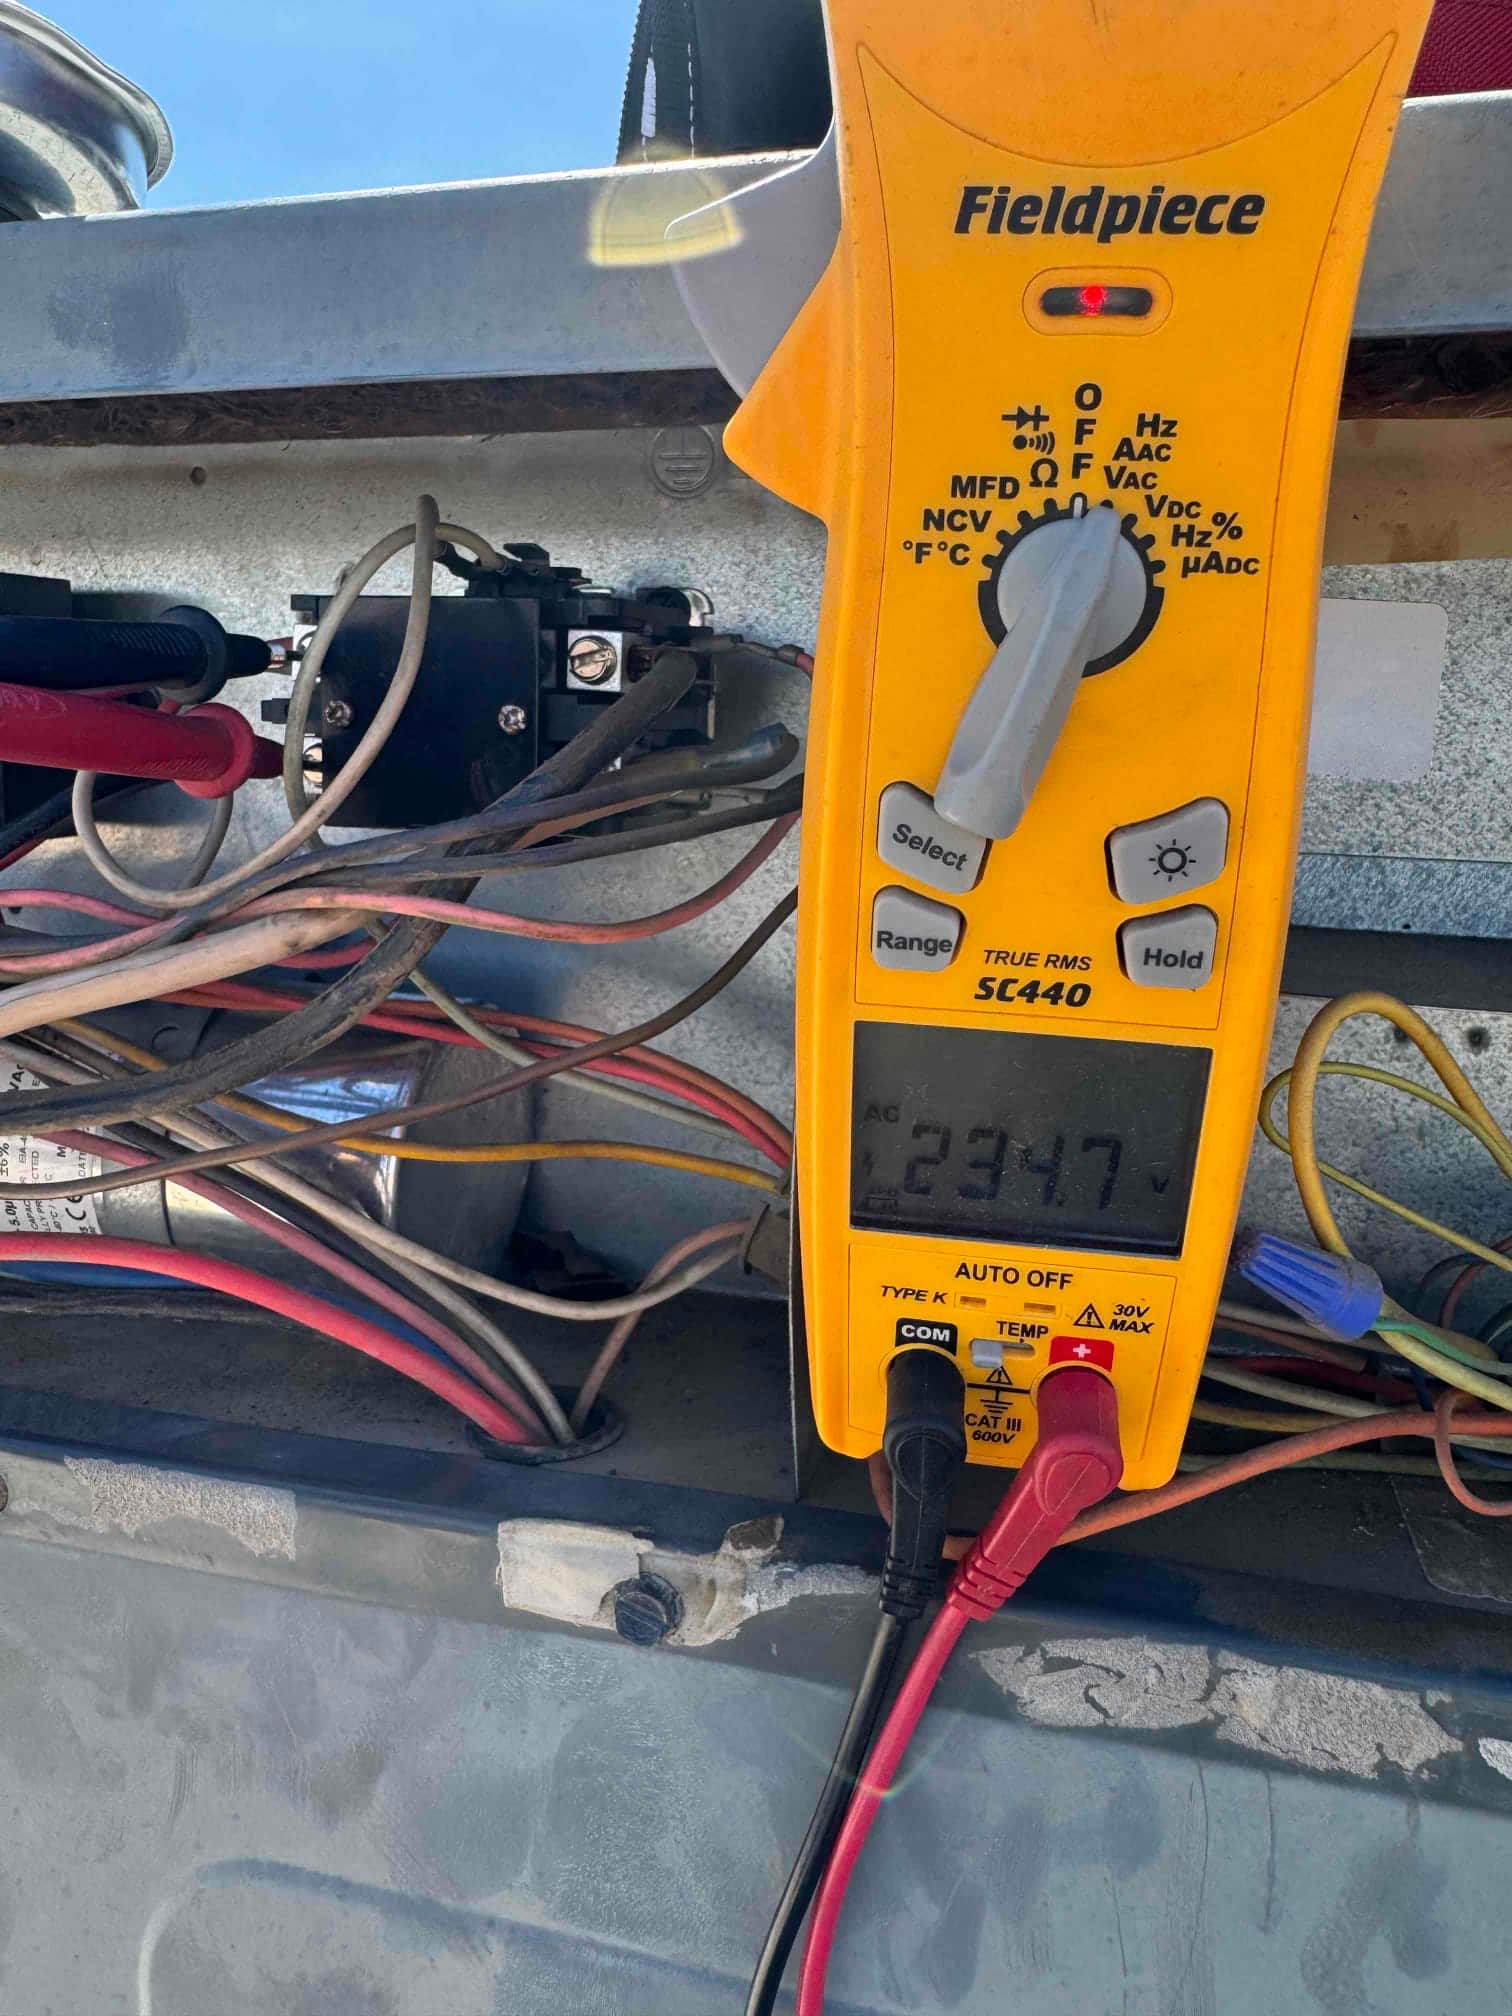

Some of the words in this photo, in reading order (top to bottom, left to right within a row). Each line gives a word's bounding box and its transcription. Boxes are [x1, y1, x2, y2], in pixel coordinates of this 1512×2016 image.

[954, 185, 1265, 244] Fieldpiece
[1136, 413, 1178, 438] Hz
[1112, 438, 1172, 462] AAC
[951, 475, 1020, 500] MFD
[1103, 465, 1158, 490] VAC
[1145, 495, 1201, 519] VDC
[923, 509, 992, 532] NCV
[892, 824, 968, 872] Select
[876, 931, 953, 957] Range
[983, 949, 1039, 967] TRUE
[1044, 954, 1092, 971] RMS
[1143, 948, 1204, 969] Hold
[974, 977, 1092, 1008] SC440
[864, 1105, 899, 1123] AC
[955, 1263, 1020, 1284] AUTO
[1027, 1271, 1073, 1290] OFF
[880, 1285, 928, 1302] TYPE
[933, 1291, 949, 1305] K
[1113, 1304, 1150, 1318] 30V
[901, 1325, 950, 1342] COM
[996, 1320, 1049, 1340] TEMP
[1108, 1319, 1155, 1334] MAX
[965, 1413, 1002, 1430] CAT
[1006, 1418, 1021, 1432] III
[971, 1430, 1016, 1444] 600V
